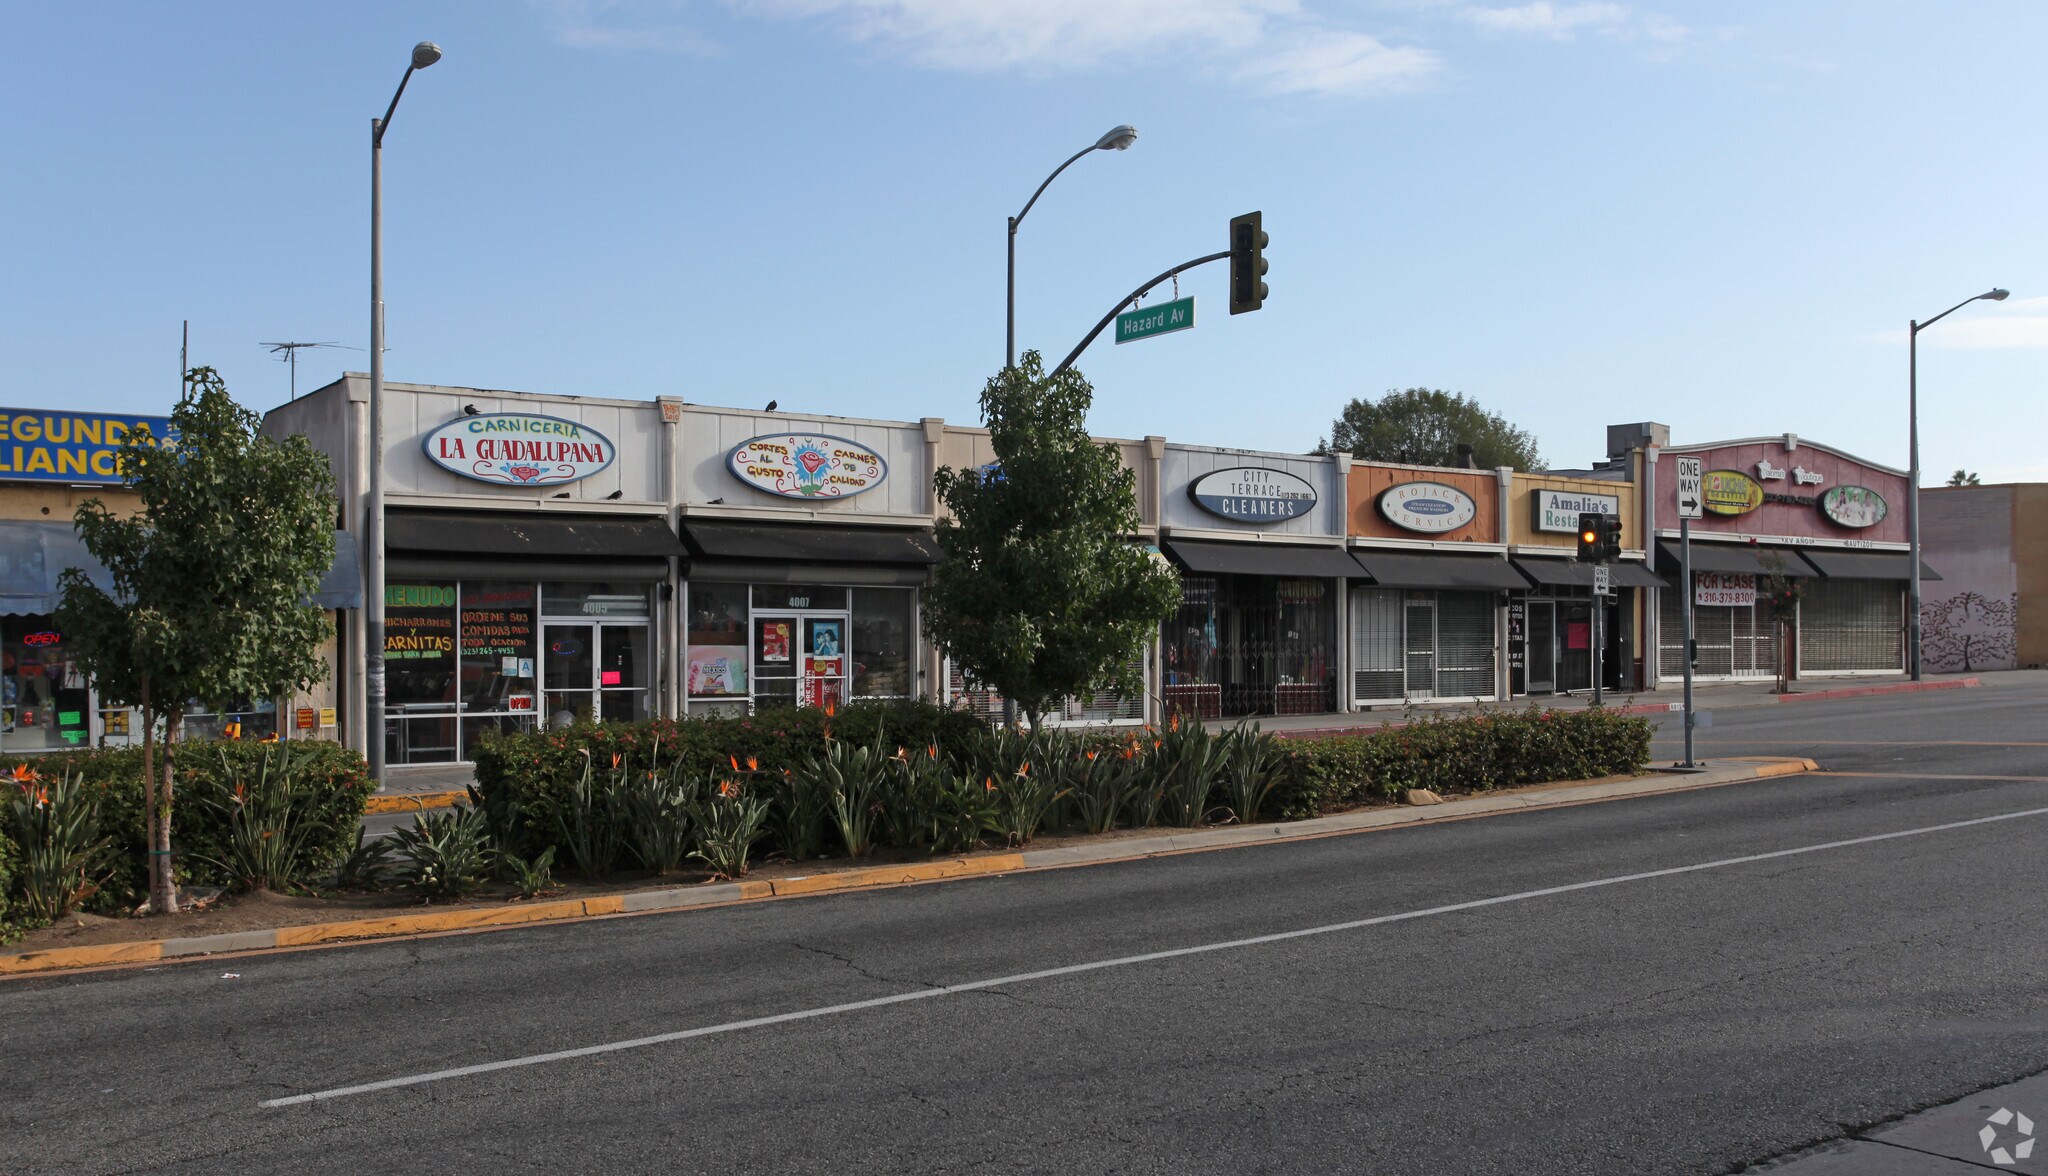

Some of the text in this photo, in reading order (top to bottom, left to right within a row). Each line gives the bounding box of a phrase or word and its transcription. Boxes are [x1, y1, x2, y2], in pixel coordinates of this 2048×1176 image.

[1124, 308, 1185, 334] Hazard Av
[468, 420, 581, 440] CARNICERIA
[439, 437, 605, 463] LA GUADALUPANA
[748, 442, 788, 456] CORTES
[760, 454, 773, 464] AL
[833, 449, 877, 466] CARNES
[747, 465, 784, 479] GUSTO
[842, 463, 856, 473] DE
[1679, 462, 1699, 477] ONE
[829, 475, 866, 487] CALIDAD
[1243, 470, 1269, 484] CITY
[1231, 482, 1281, 497] TERRACE
[1679, 478, 1700, 494] WAY
[1398, 487, 1461, 504] ROJACK
[1222, 498, 1294, 516] CLEANERS
[1549, 494, 1609, 514] Amalia's
[1392, 509, 1466, 528] SERVICE
[1595, 568, 1607, 576] ONE
[1697, 573, 1754, 590] FOR LEASE
[789, 597, 810, 608] 4007
[1704, 592, 1754, 603] 310-379-8300
[582, 602, 608, 614] 4005
[462, 612, 529, 623] ORDENE SUS
[462, 626, 511, 637] COMIDAS
[24, 634, 59, 645] OPEN
[384, 636, 452, 651] ARNITAS
[461, 639, 527, 647] TODA OCACION
[522, 662, 530, 671] A
[510, 697, 532, 710] OPEN
